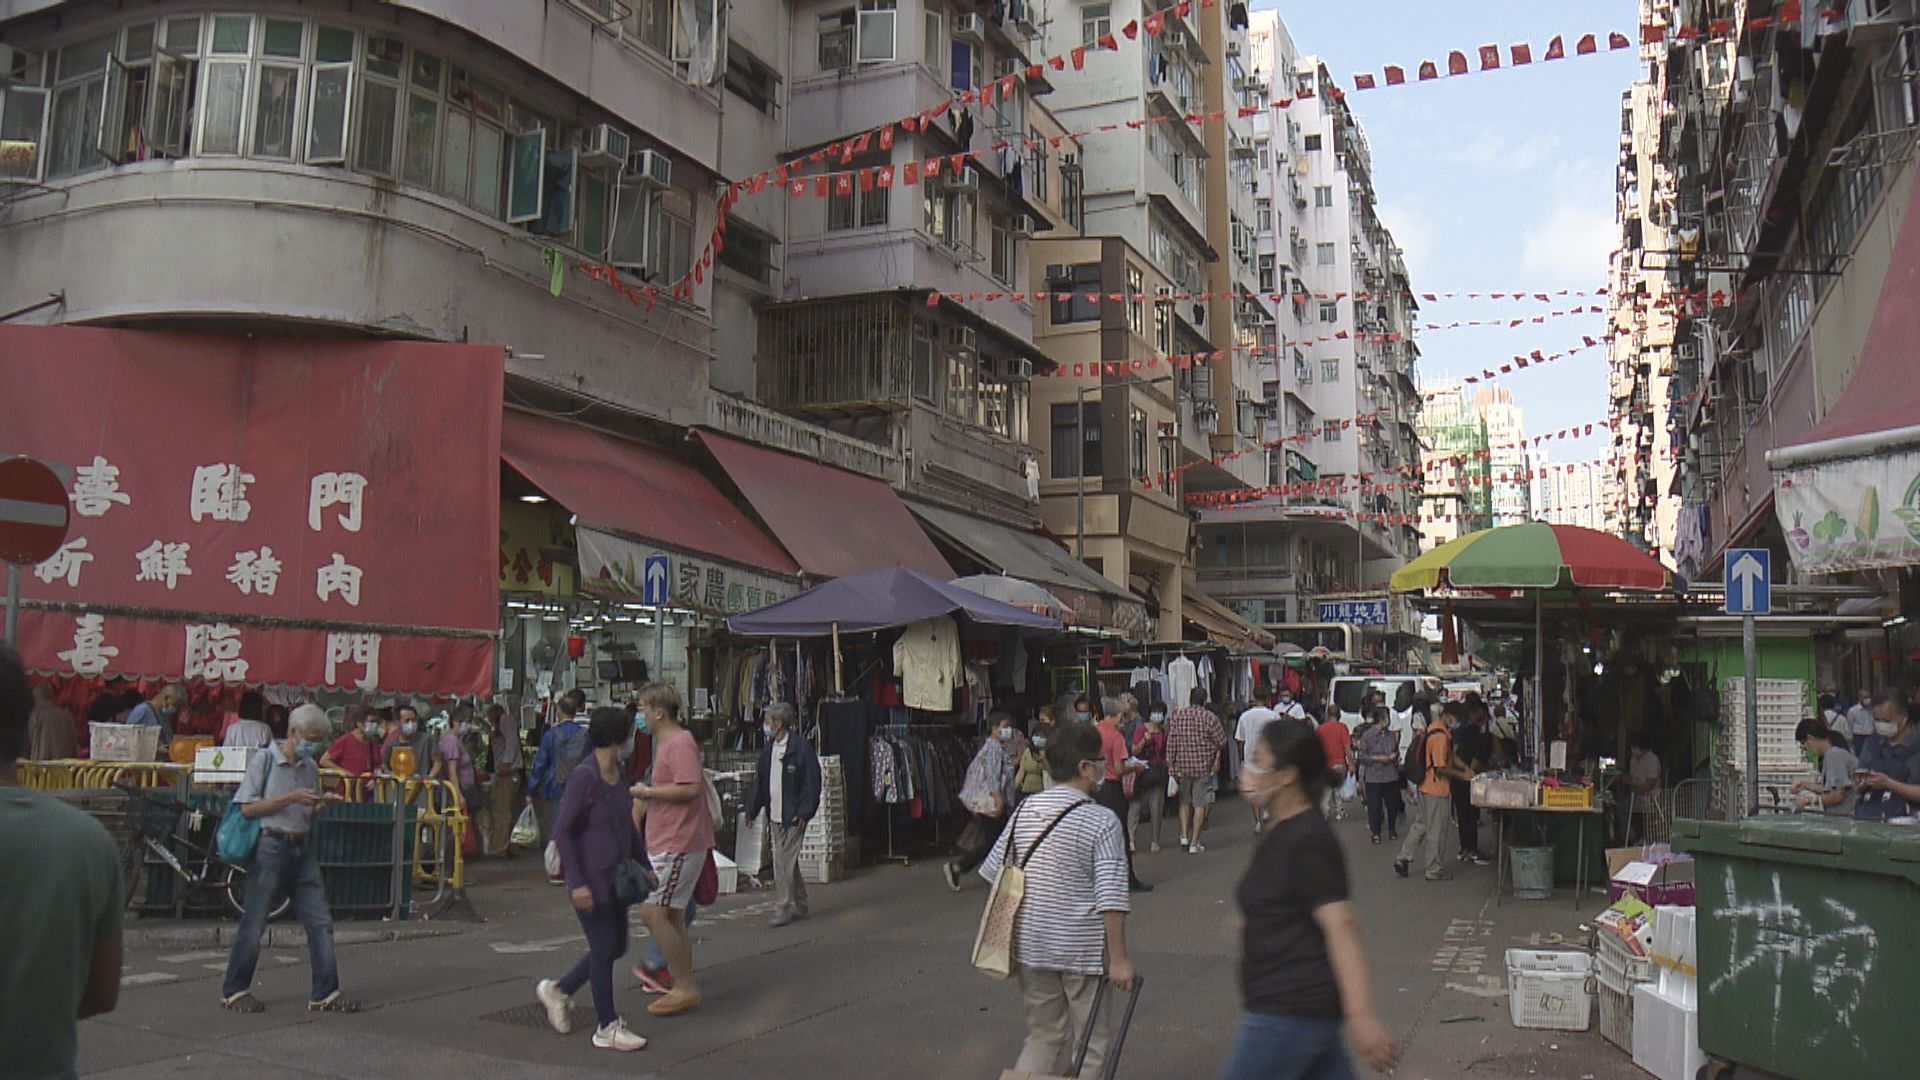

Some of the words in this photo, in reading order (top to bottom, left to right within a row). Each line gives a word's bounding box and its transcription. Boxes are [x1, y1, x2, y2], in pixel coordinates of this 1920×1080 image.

[68, 456, 368, 532] 喜臨門
[57, 613, 382, 691] 喜臨門
